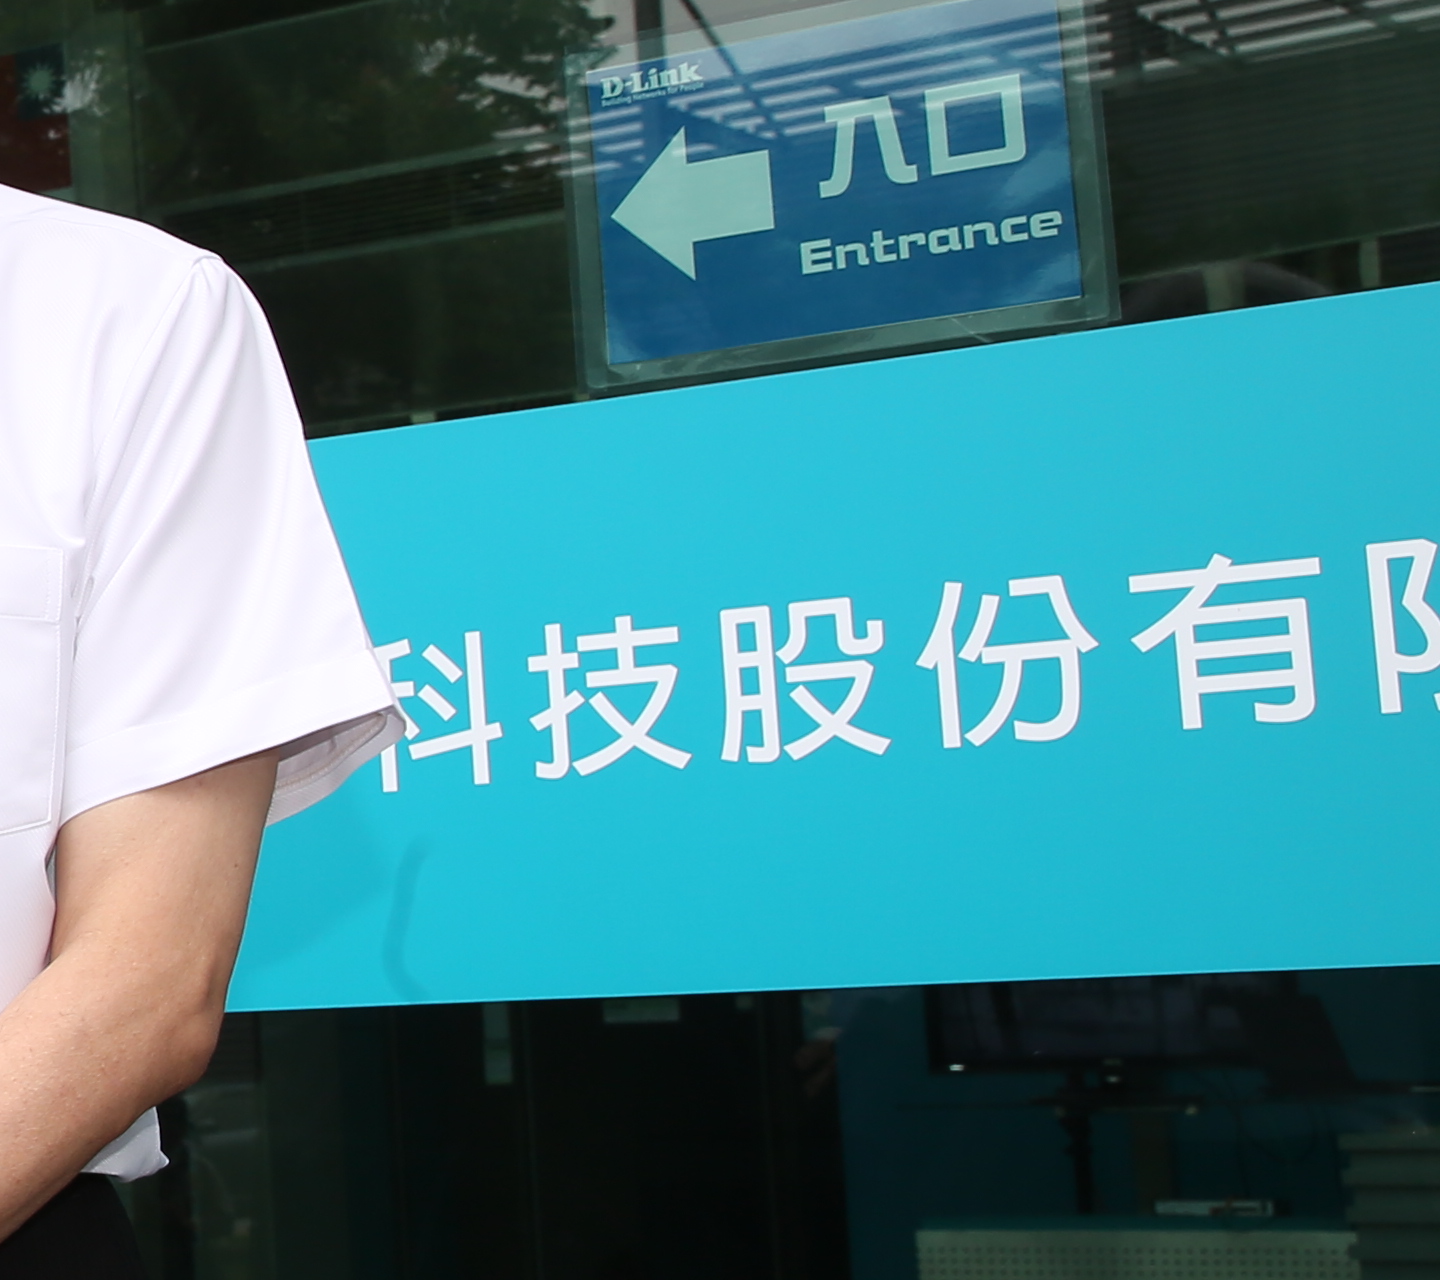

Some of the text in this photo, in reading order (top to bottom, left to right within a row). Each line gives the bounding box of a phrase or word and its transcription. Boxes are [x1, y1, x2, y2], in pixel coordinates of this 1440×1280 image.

[600, 62, 703, 99] D-Link
[819, 73, 1026, 198] 入口
[800, 210, 1062, 275] Entrance
